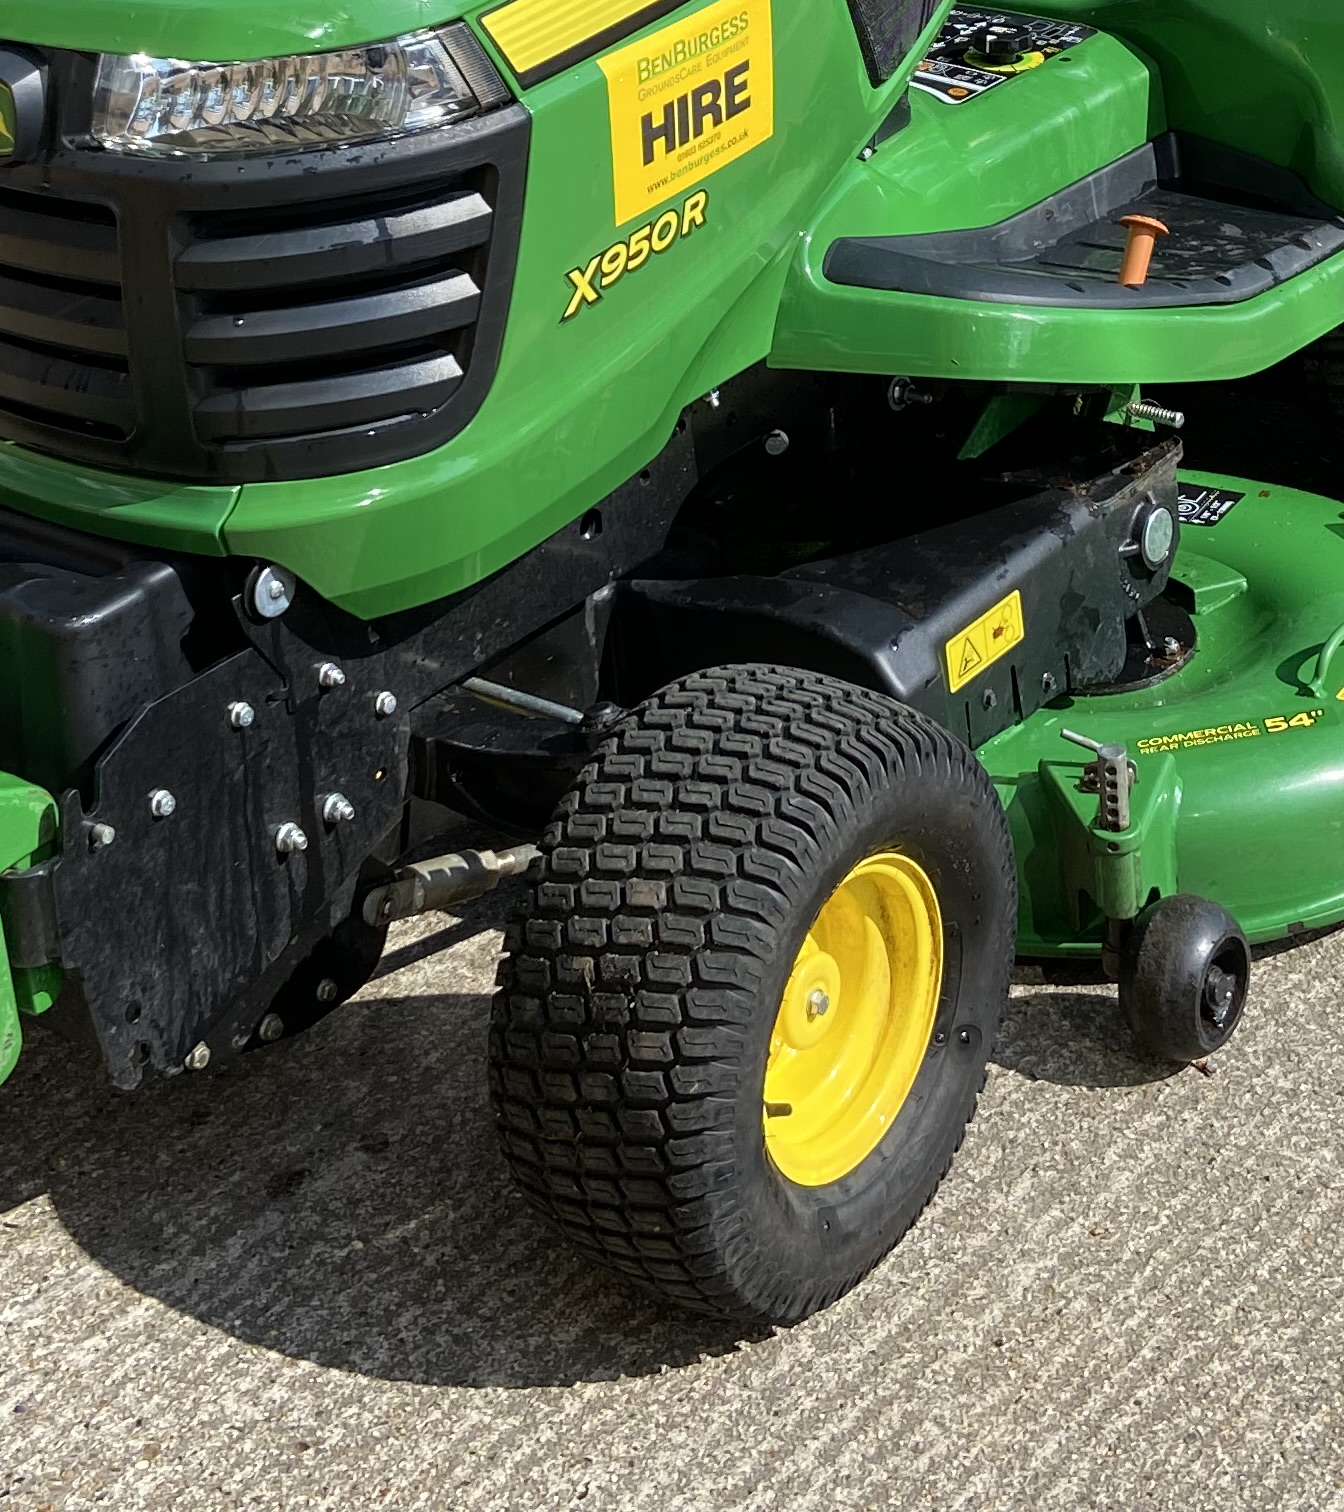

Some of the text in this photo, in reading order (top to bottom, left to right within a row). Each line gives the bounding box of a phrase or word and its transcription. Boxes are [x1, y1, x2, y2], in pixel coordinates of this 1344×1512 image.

[706, 36, 750, 66] EQUIPMENT
[641, 59, 751, 167] HIRE
[647, 128, 749, 194] www.benburgess.co.uk
[1136, 721, 1258, 748] COMMERCIAL
[1264, 709, 1324, 733] 54"
[1140, 728, 1261, 755] REAR DISCHARGE
